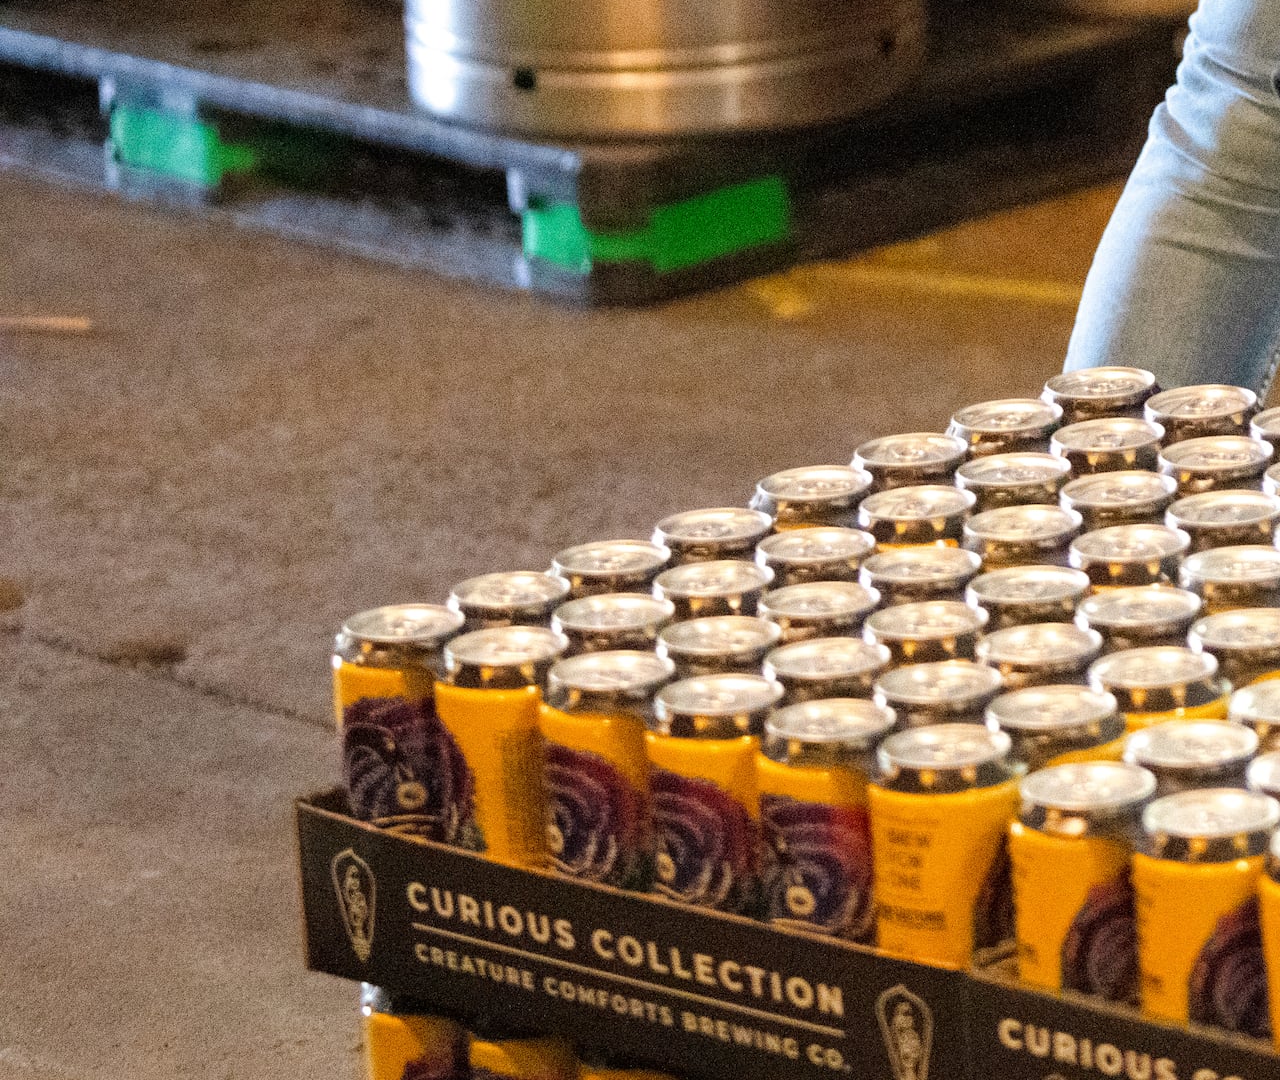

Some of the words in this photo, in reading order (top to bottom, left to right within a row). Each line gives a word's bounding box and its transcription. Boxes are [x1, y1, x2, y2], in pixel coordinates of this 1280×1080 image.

[406, 881, 576, 951] CURIOUS
[591, 928, 846, 1017] COLLECTION
[414, 943, 535, 992] CREATURE
[542, 976, 674, 1027] COMFORTS
[680, 1011, 800, 1060] BREWING
[805, 1043, 852, 1072] CO.
[998, 1018, 1178, 1080] CURIOUS
